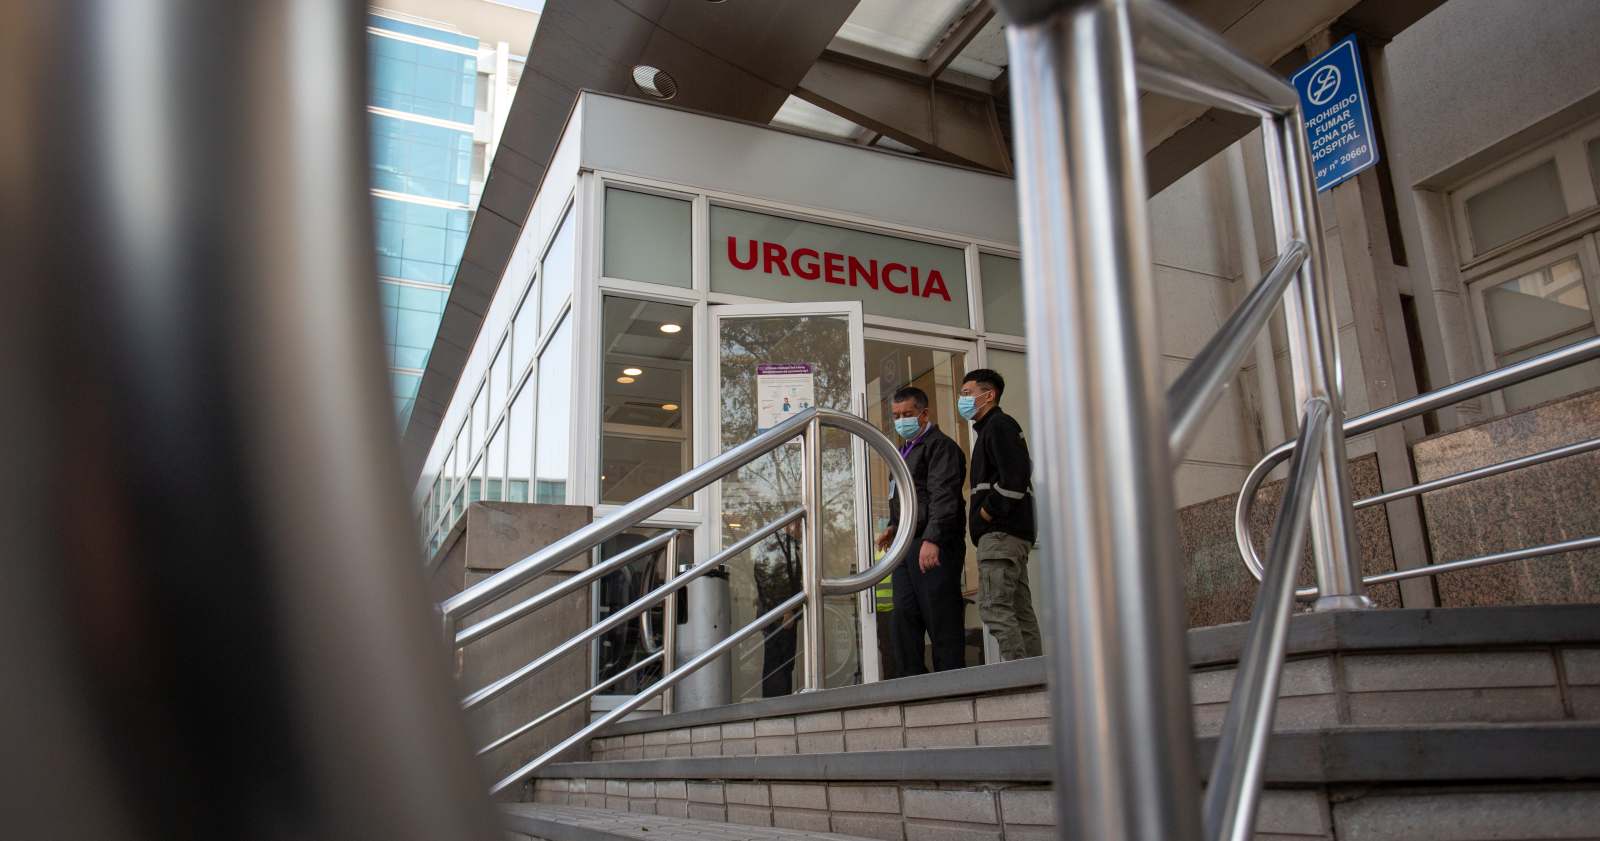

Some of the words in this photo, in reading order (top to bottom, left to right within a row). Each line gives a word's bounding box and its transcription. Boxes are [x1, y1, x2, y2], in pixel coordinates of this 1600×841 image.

[1312, 129, 1340, 150] ZONA
[1341, 119, 1356, 133] DE
[1315, 110, 1351, 136] FUMAR
[1312, 130, 1360, 162] HOSPITAL
[1340, 145, 1367, 165] 20660
[727, 236, 951, 301] URGENCIA
